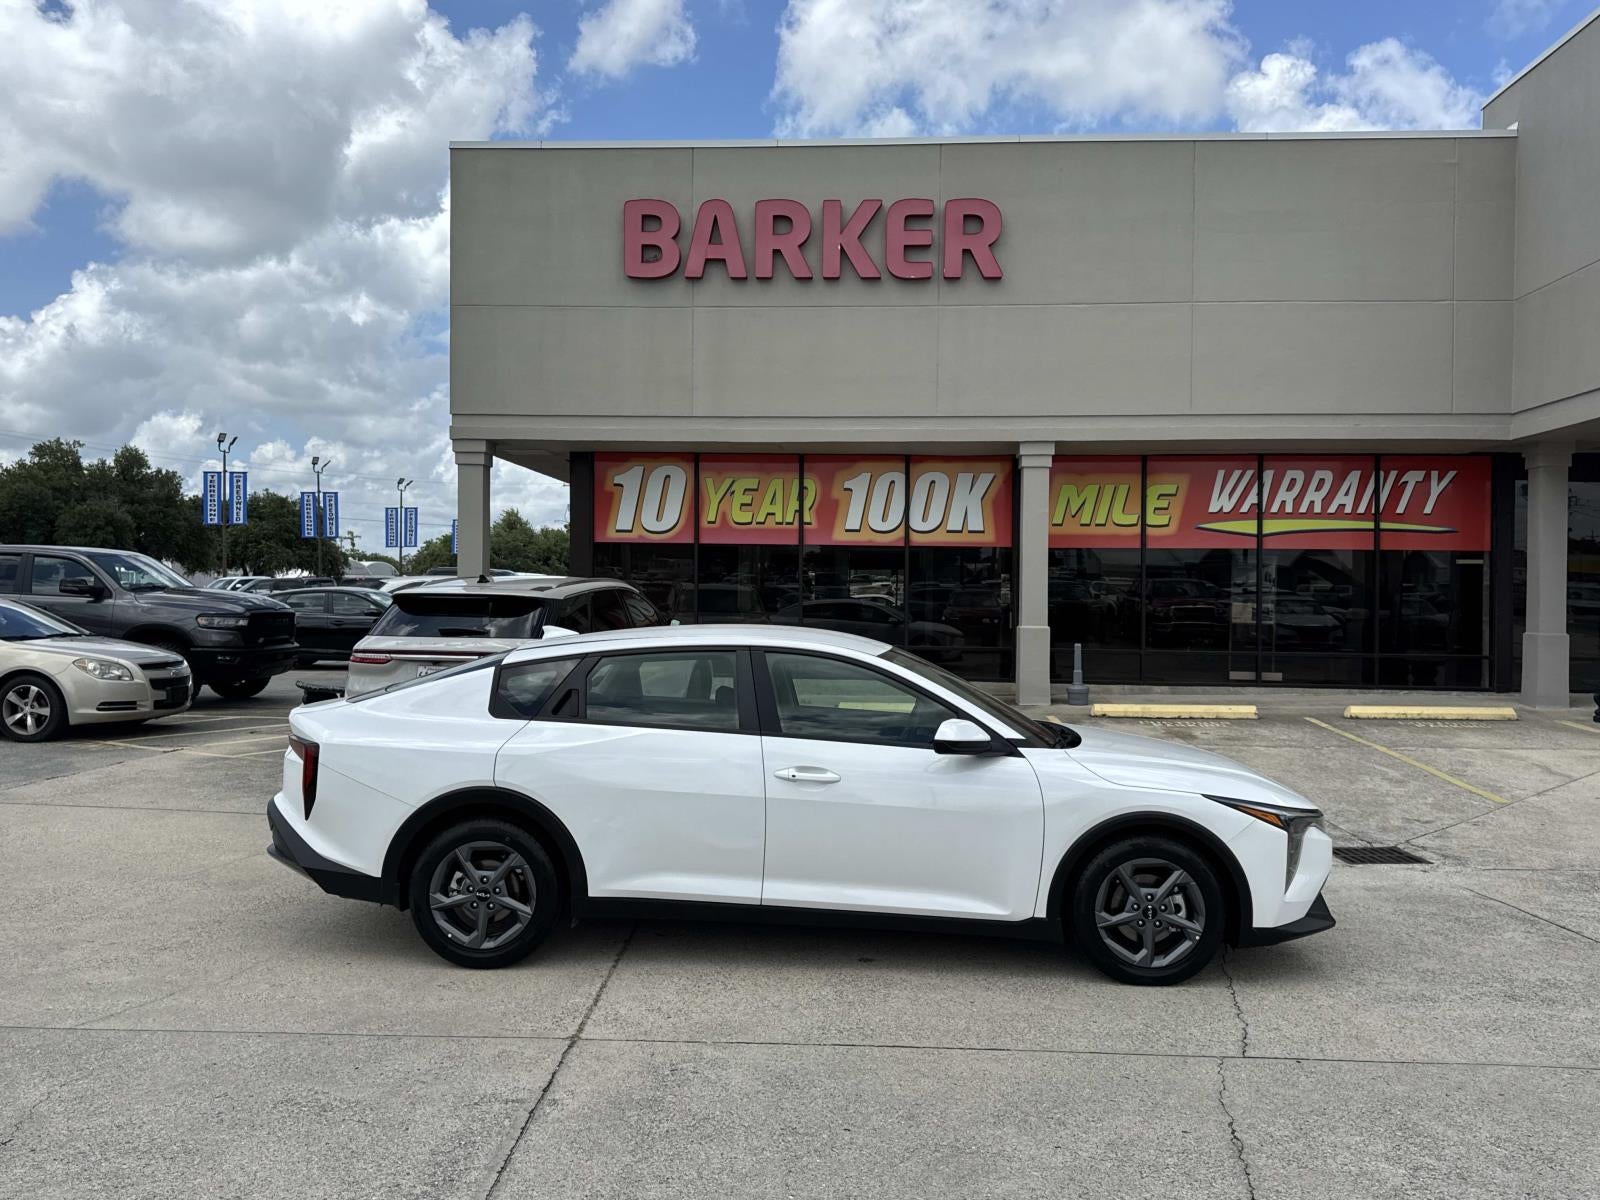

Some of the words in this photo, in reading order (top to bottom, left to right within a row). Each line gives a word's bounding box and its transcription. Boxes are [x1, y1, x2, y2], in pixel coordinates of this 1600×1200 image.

[623, 198, 1004, 280] BARKER
[613, 464, 688, 535] 10
[704, 476, 817, 526] YEAR
[843, 471, 996, 534] 100K
[1052, 483, 1180, 528] MILE
[1208, 469, 1458, 515] WARRANTY
